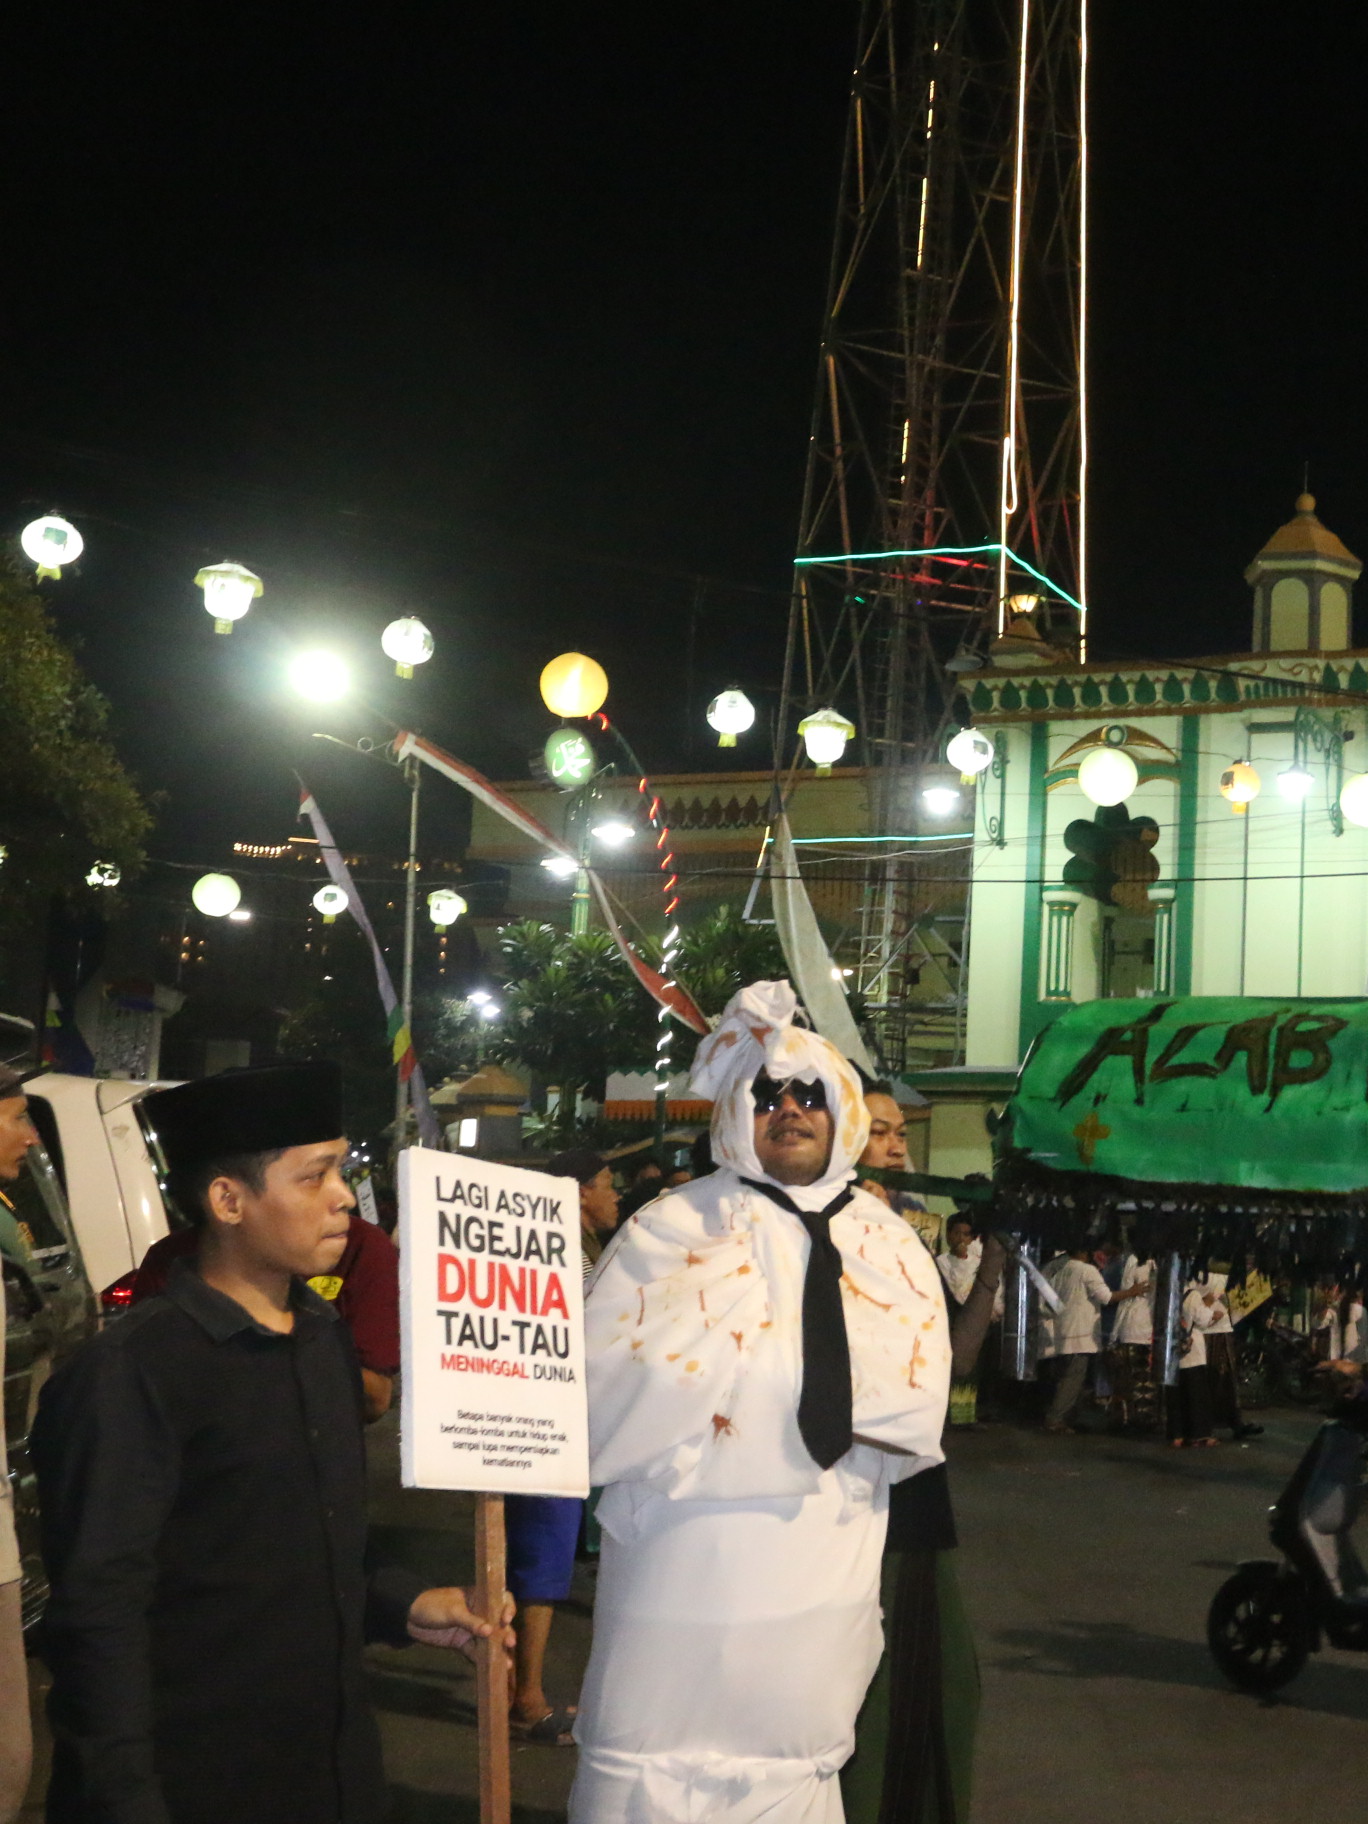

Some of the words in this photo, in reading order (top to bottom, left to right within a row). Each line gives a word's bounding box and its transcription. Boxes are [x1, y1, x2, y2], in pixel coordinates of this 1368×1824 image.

[436, 1176, 489, 1211] LAGI
[495, 1189, 563, 1224] ASYIK
[438, 1211, 567, 1267] NGEJAR
[437, 1253, 569, 1320] DUNIA
[436, 1310, 570, 1359] TAU-TAU
[440, 1353, 529, 1379] MENINGGAL
[533, 1364, 576, 1383] DUNIA
